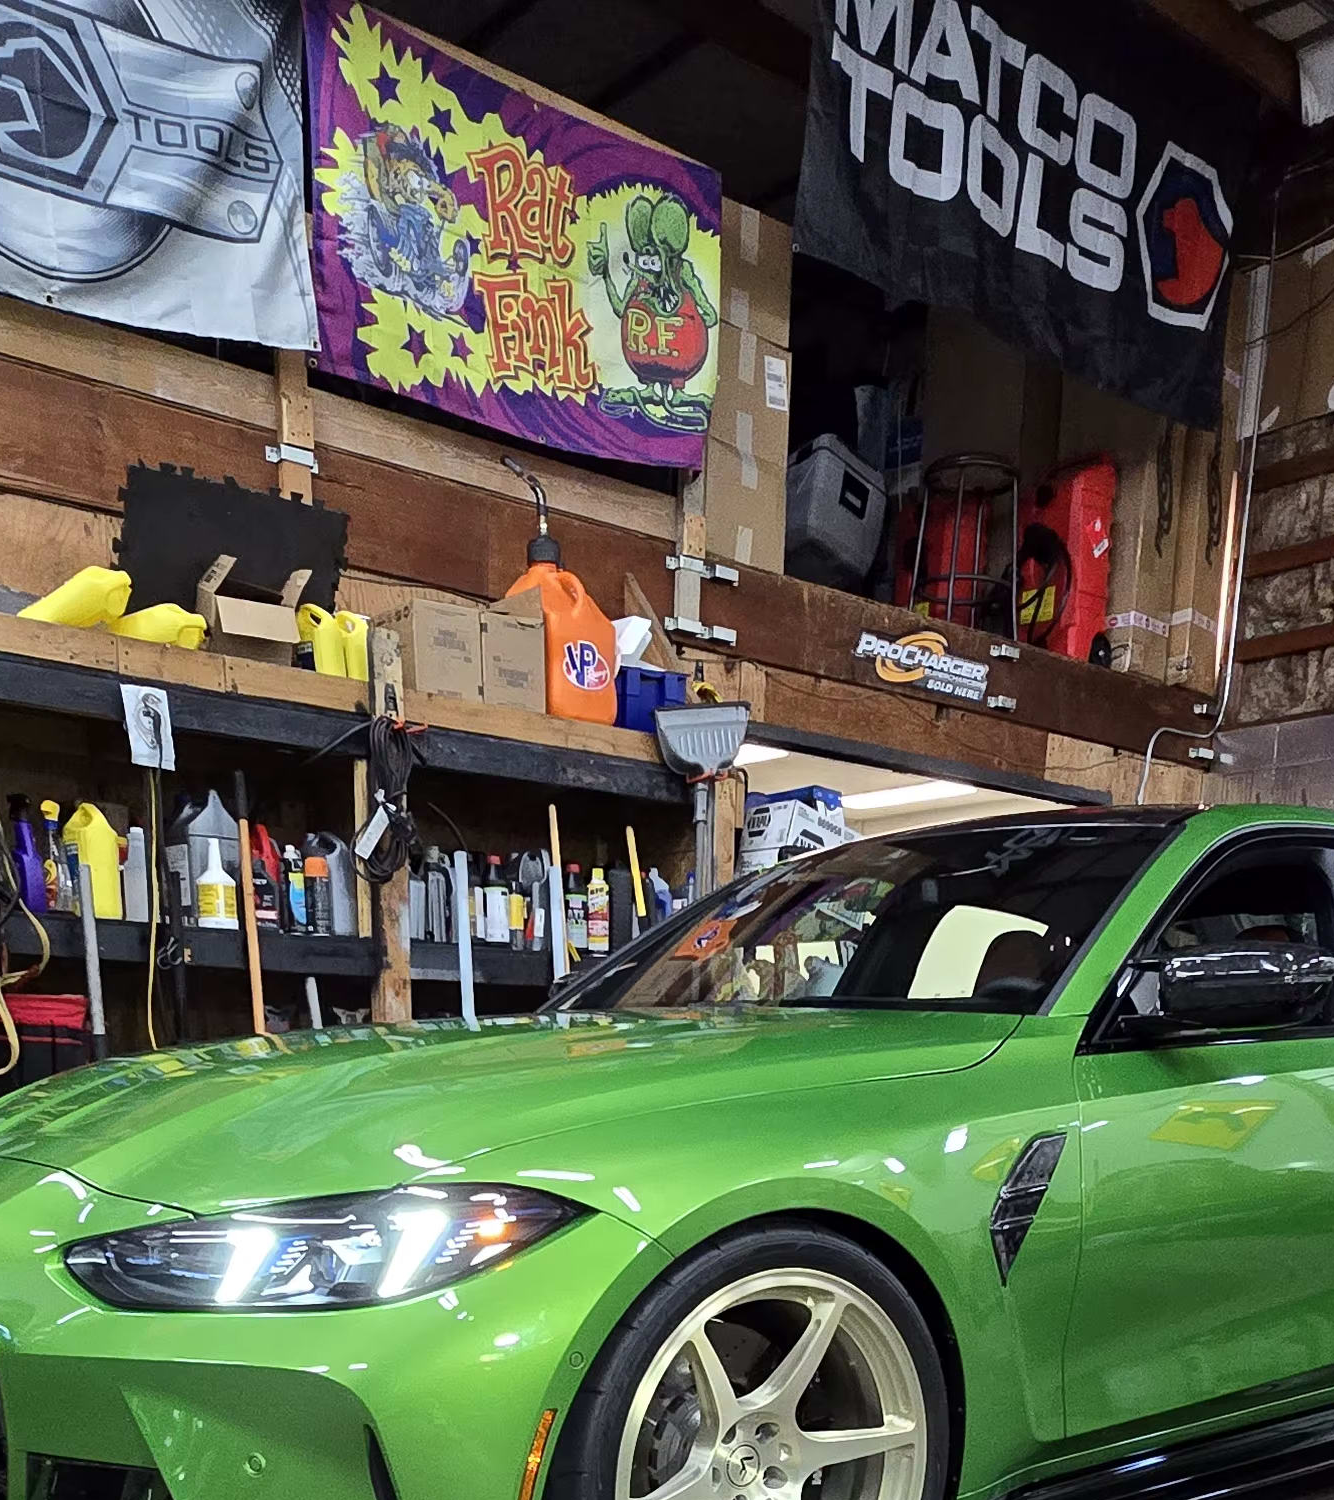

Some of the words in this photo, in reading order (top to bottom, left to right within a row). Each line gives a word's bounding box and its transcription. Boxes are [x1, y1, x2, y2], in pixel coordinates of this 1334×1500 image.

[121, 108, 271, 174] TOOLS
[831, 30, 1128, 292] TOOLS
[469, 143, 577, 268] Rat
[473, 273, 601, 394] Fink
[626, 311, 684, 361] R.F.
[564, 641, 598, 688] VP
[926, 678, 954, 695] SOLD
[953, 685, 982, 700] HERE
